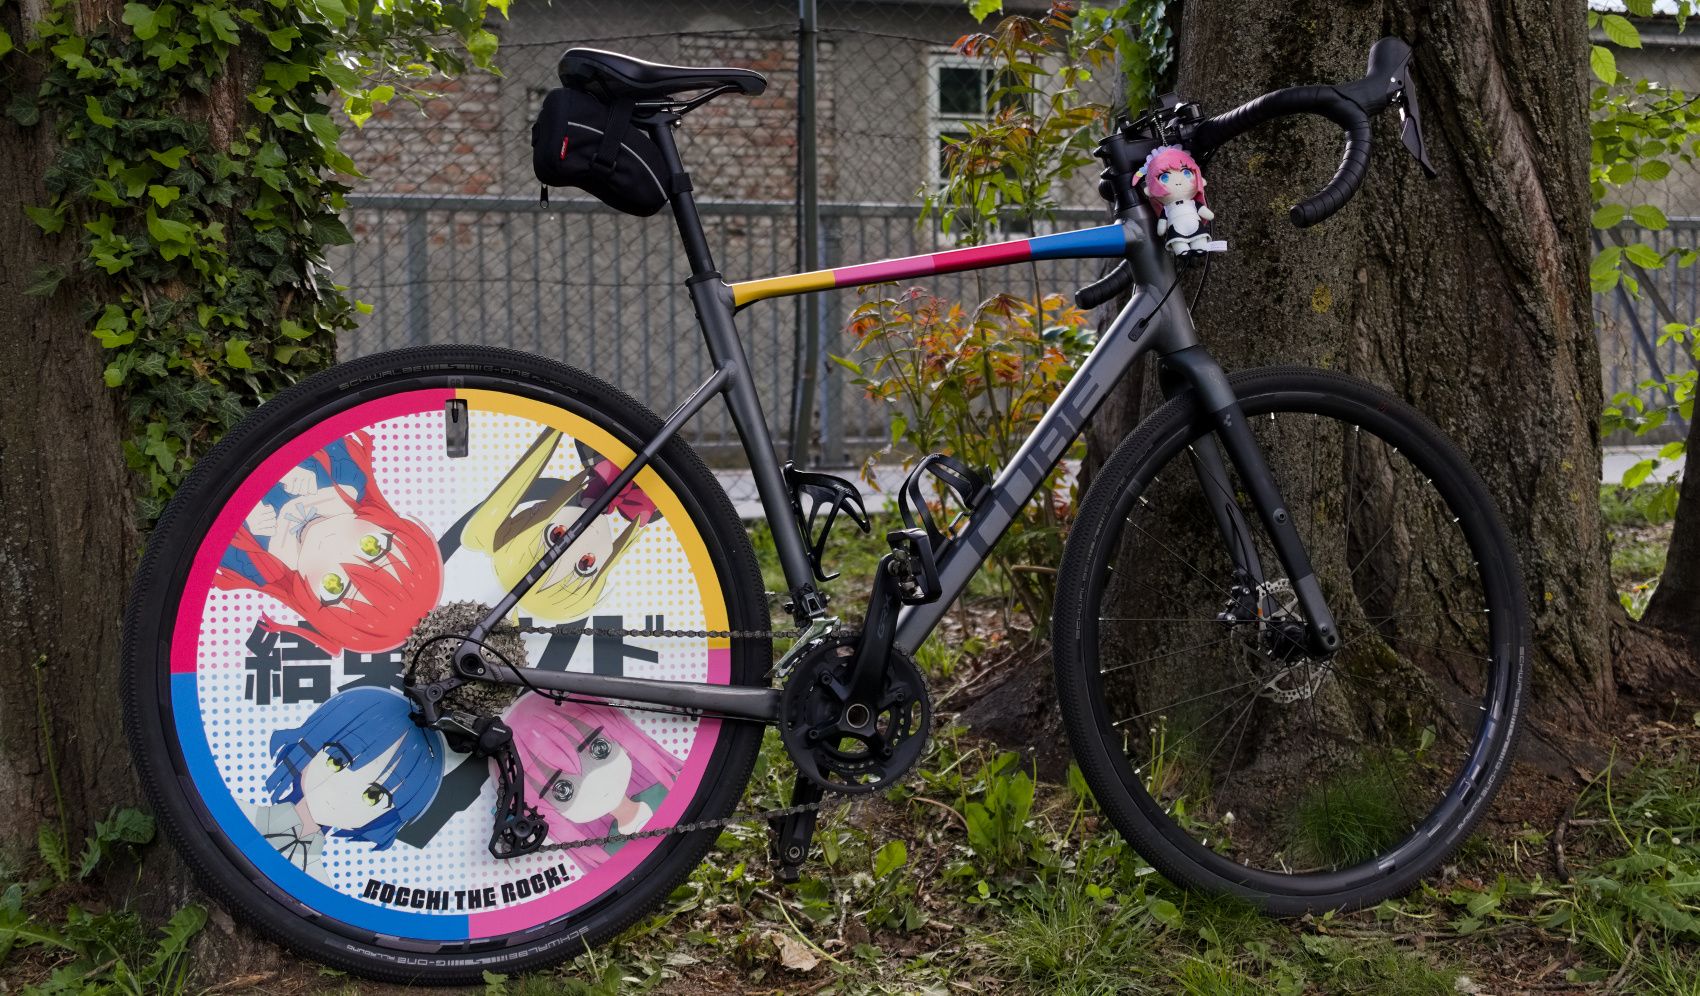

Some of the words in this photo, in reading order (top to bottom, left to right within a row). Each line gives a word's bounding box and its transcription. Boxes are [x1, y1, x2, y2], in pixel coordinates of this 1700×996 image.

[338, 363, 425, 391] SCHWALBE
[454, 886, 497, 911] THE
[501, 863, 571, 904] ROCK!
[508, 925, 590, 961] SCHWALBE
